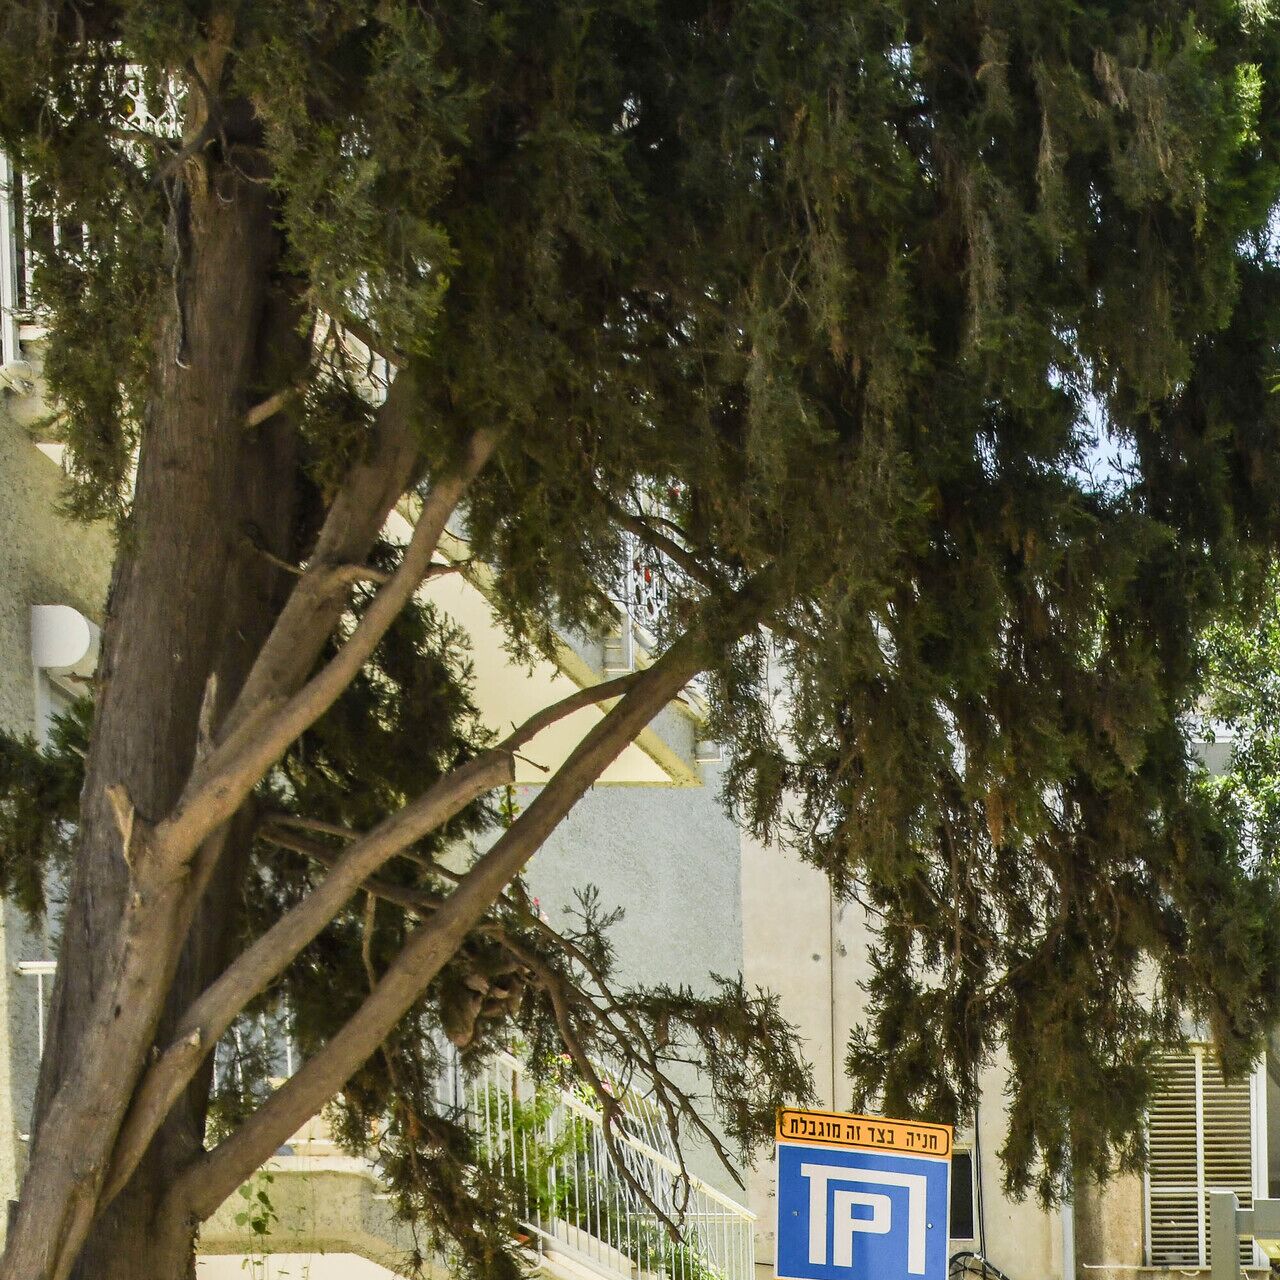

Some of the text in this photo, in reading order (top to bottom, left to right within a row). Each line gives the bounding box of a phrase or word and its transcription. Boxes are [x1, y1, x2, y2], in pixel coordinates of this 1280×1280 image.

[790, 1117, 938, 1150] חניה בצד זה מוגבלת
